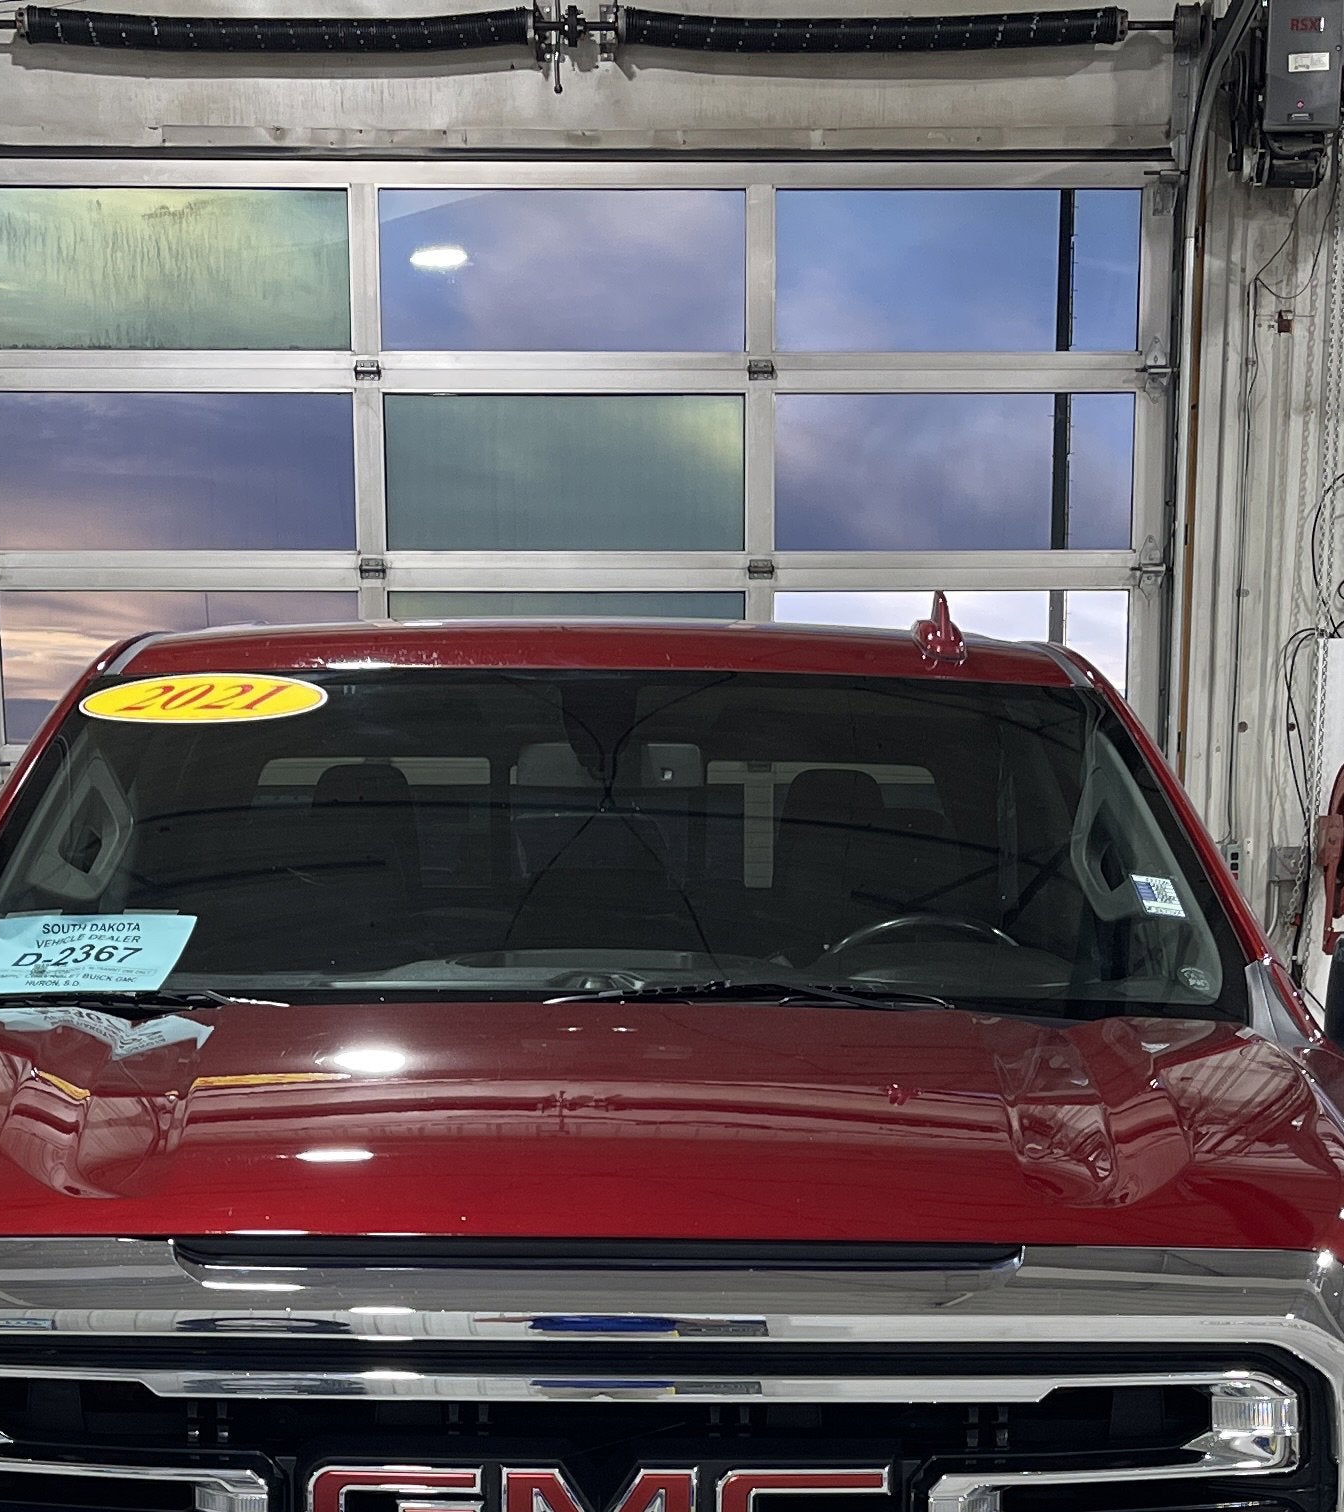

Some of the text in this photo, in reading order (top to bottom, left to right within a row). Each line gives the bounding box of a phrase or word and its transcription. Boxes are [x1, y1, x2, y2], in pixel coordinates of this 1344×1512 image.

[119, 684, 292, 712] 2021
[42, 922, 141, 934] SOUTH DAKOTA
[36, 933, 142, 949] VEHICLE DEALER
[11, 944, 143, 967] D-2367
